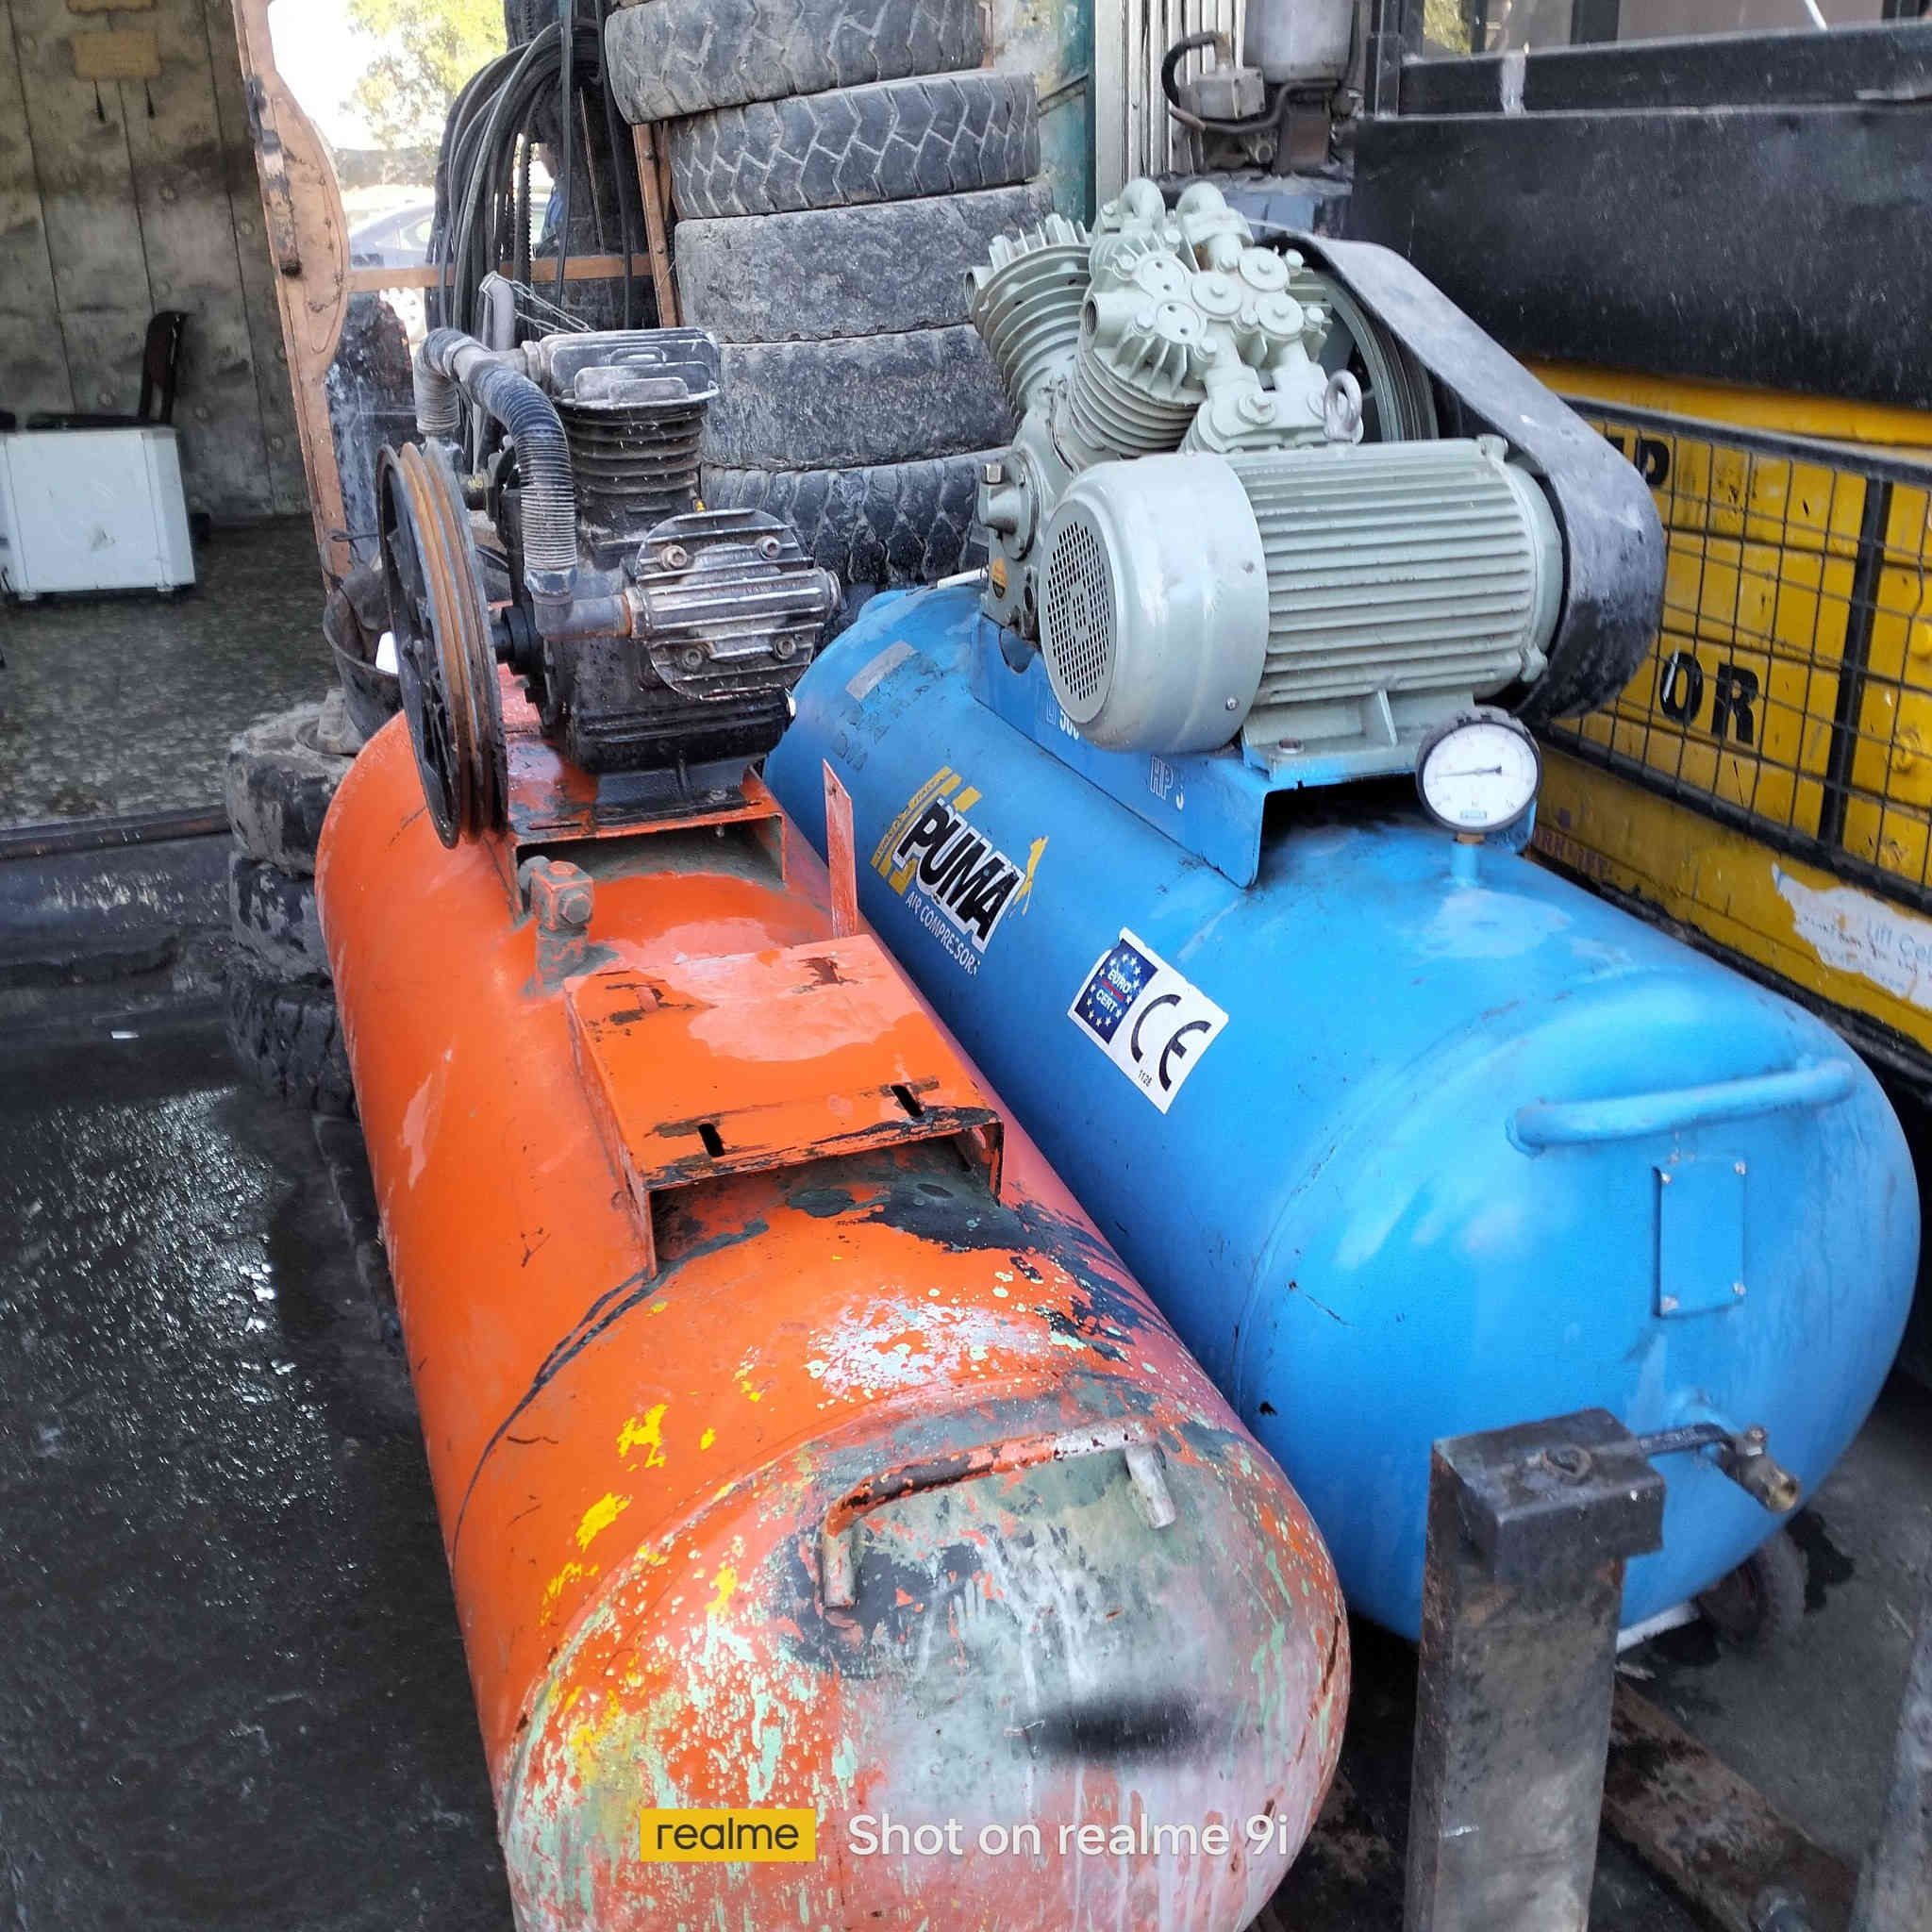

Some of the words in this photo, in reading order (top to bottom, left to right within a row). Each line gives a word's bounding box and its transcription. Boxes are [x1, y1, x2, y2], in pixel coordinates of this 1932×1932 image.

[895, 799, 1025, 943] PUMA
[906, 891, 923, 914] AIR
[1108, 969, 1132, 993] EURO
[1096, 989, 1118, 1012] CERT
[1131, 993, 1212, 1091] CE
